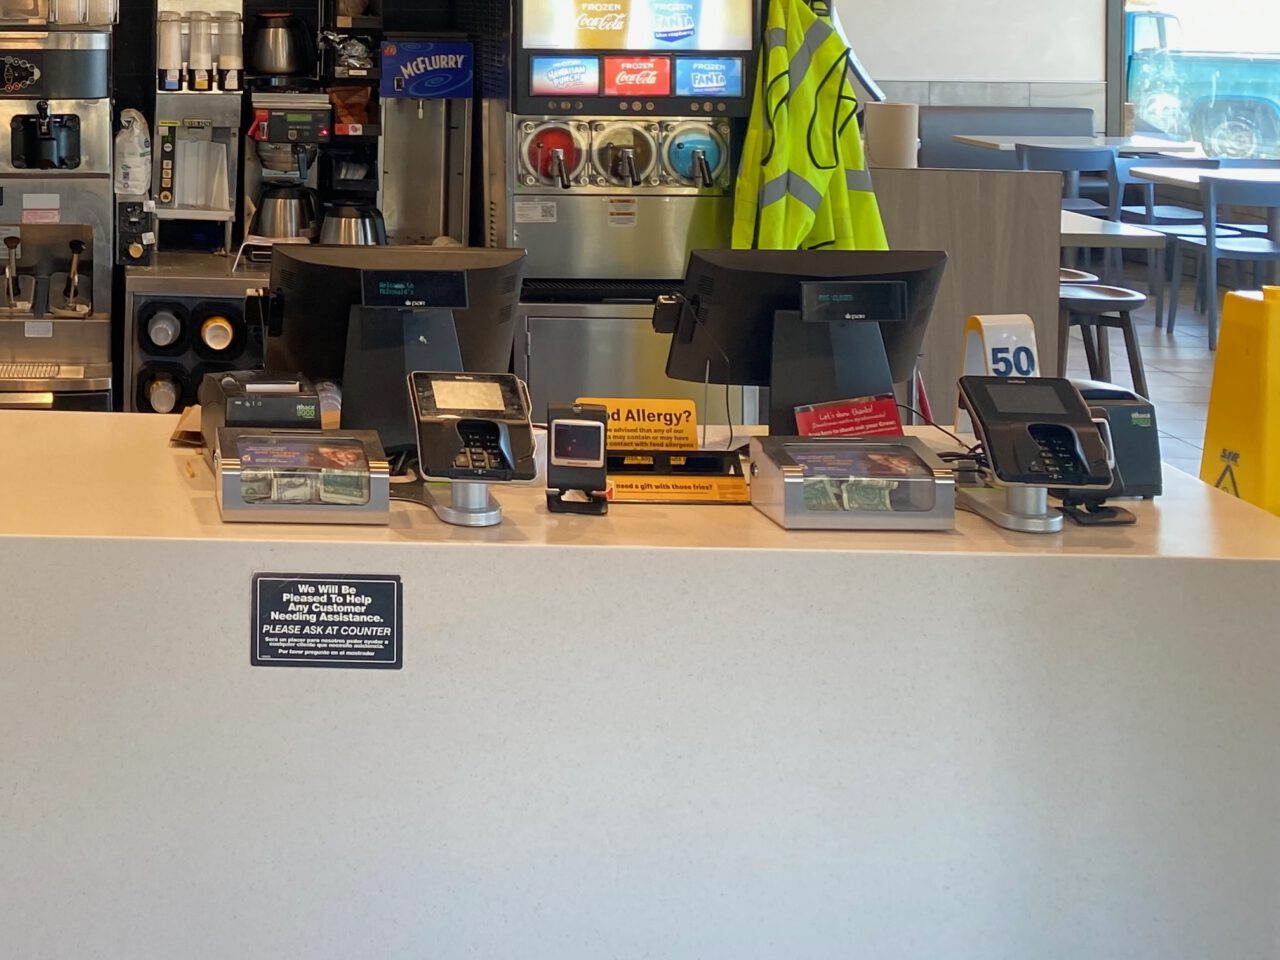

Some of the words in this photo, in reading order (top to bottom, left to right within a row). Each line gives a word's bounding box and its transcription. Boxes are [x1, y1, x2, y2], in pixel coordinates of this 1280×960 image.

[582, 3, 621, 11] FROZEN
[655, 3, 693, 11] FROZEN
[576, 13, 627, 31] Coca-Cola
[654, 13, 694, 28] FANTA
[400, 54, 465, 80] MCFLURRY
[693, 63, 725, 71] FROZEN
[615, 71, 657, 85] Coca-Cola
[692, 73, 726, 87] FANTA
[991, 346, 1035, 377] 50
[625, 408, 691, 426] Allergy?
[640, 483, 653, 491] gift
[298, 584, 315, 594] We
[318, 585, 338, 594] Will
[341, 585, 356, 594] Be
[282, 593, 327, 603] Pleased
[330, 595, 343, 603] To
[346, 595, 372, 605] Help
[288, 603, 309, 613] Any
[312, 603, 366, 613] Customer
[270, 612, 316, 622] Needing
[319, 613, 384, 622] Assistance.
[263, 625, 300, 634] PLEASE
[303, 626, 324, 634] ASK
[325, 626, 338, 634] AT
[341, 626, 391, 635] COUNTER
